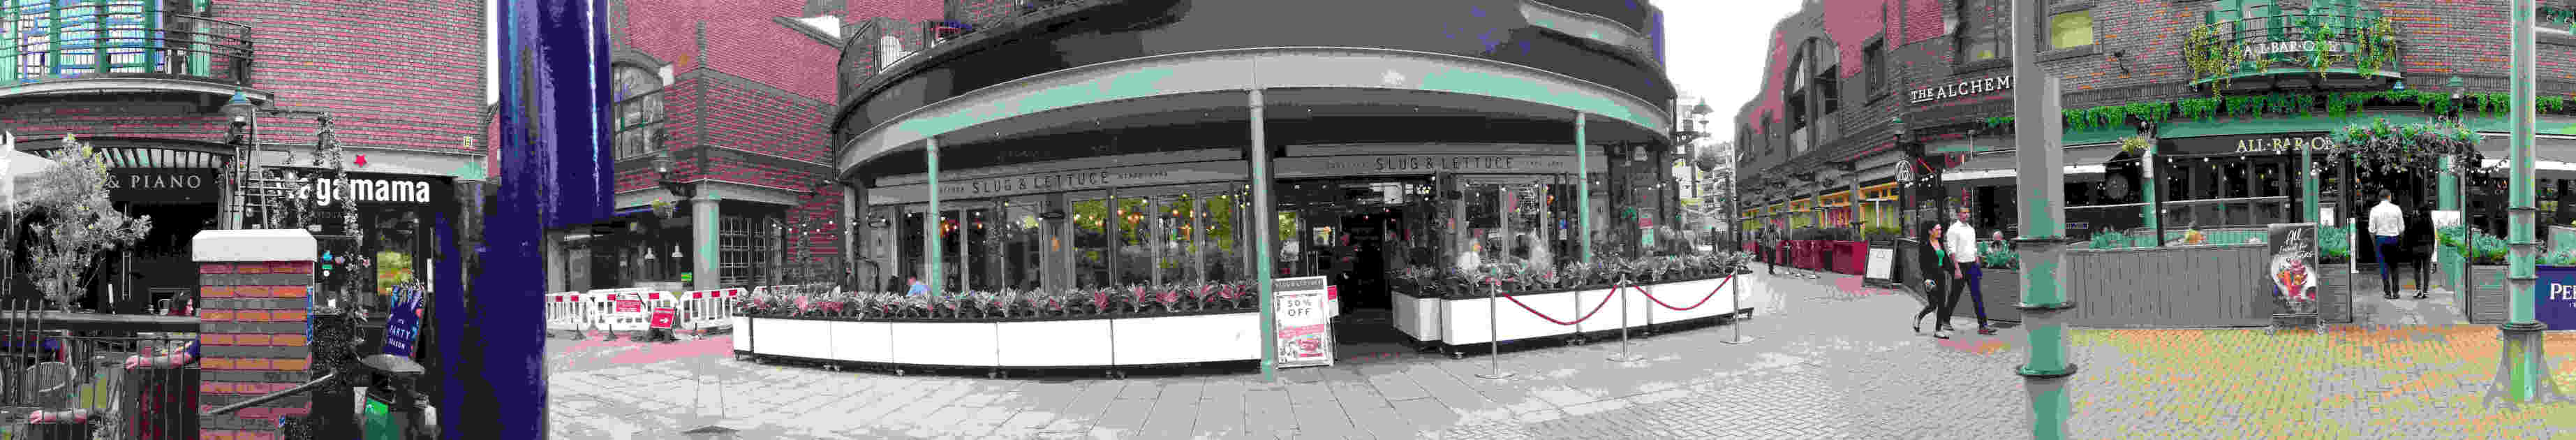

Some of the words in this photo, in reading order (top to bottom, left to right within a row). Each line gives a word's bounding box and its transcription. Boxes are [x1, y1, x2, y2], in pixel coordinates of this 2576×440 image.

[2244, 43, 2267, 56] AL
[1911, 88, 1933, 101] THE
[1374, 156, 1418, 170] SLUG
[1426, 156, 1434, 170] &
[1442, 156, 1513, 170] LETTUCE
[106, 175, 121, 189] &
[130, 175, 201, 189] PIANO
[971, 180, 1012, 194] SLUG
[1018, 177, 1028, 190] &
[1033, 171, 1110, 190] LETTUCE
[1288, 307, 1312, 317] OFF
